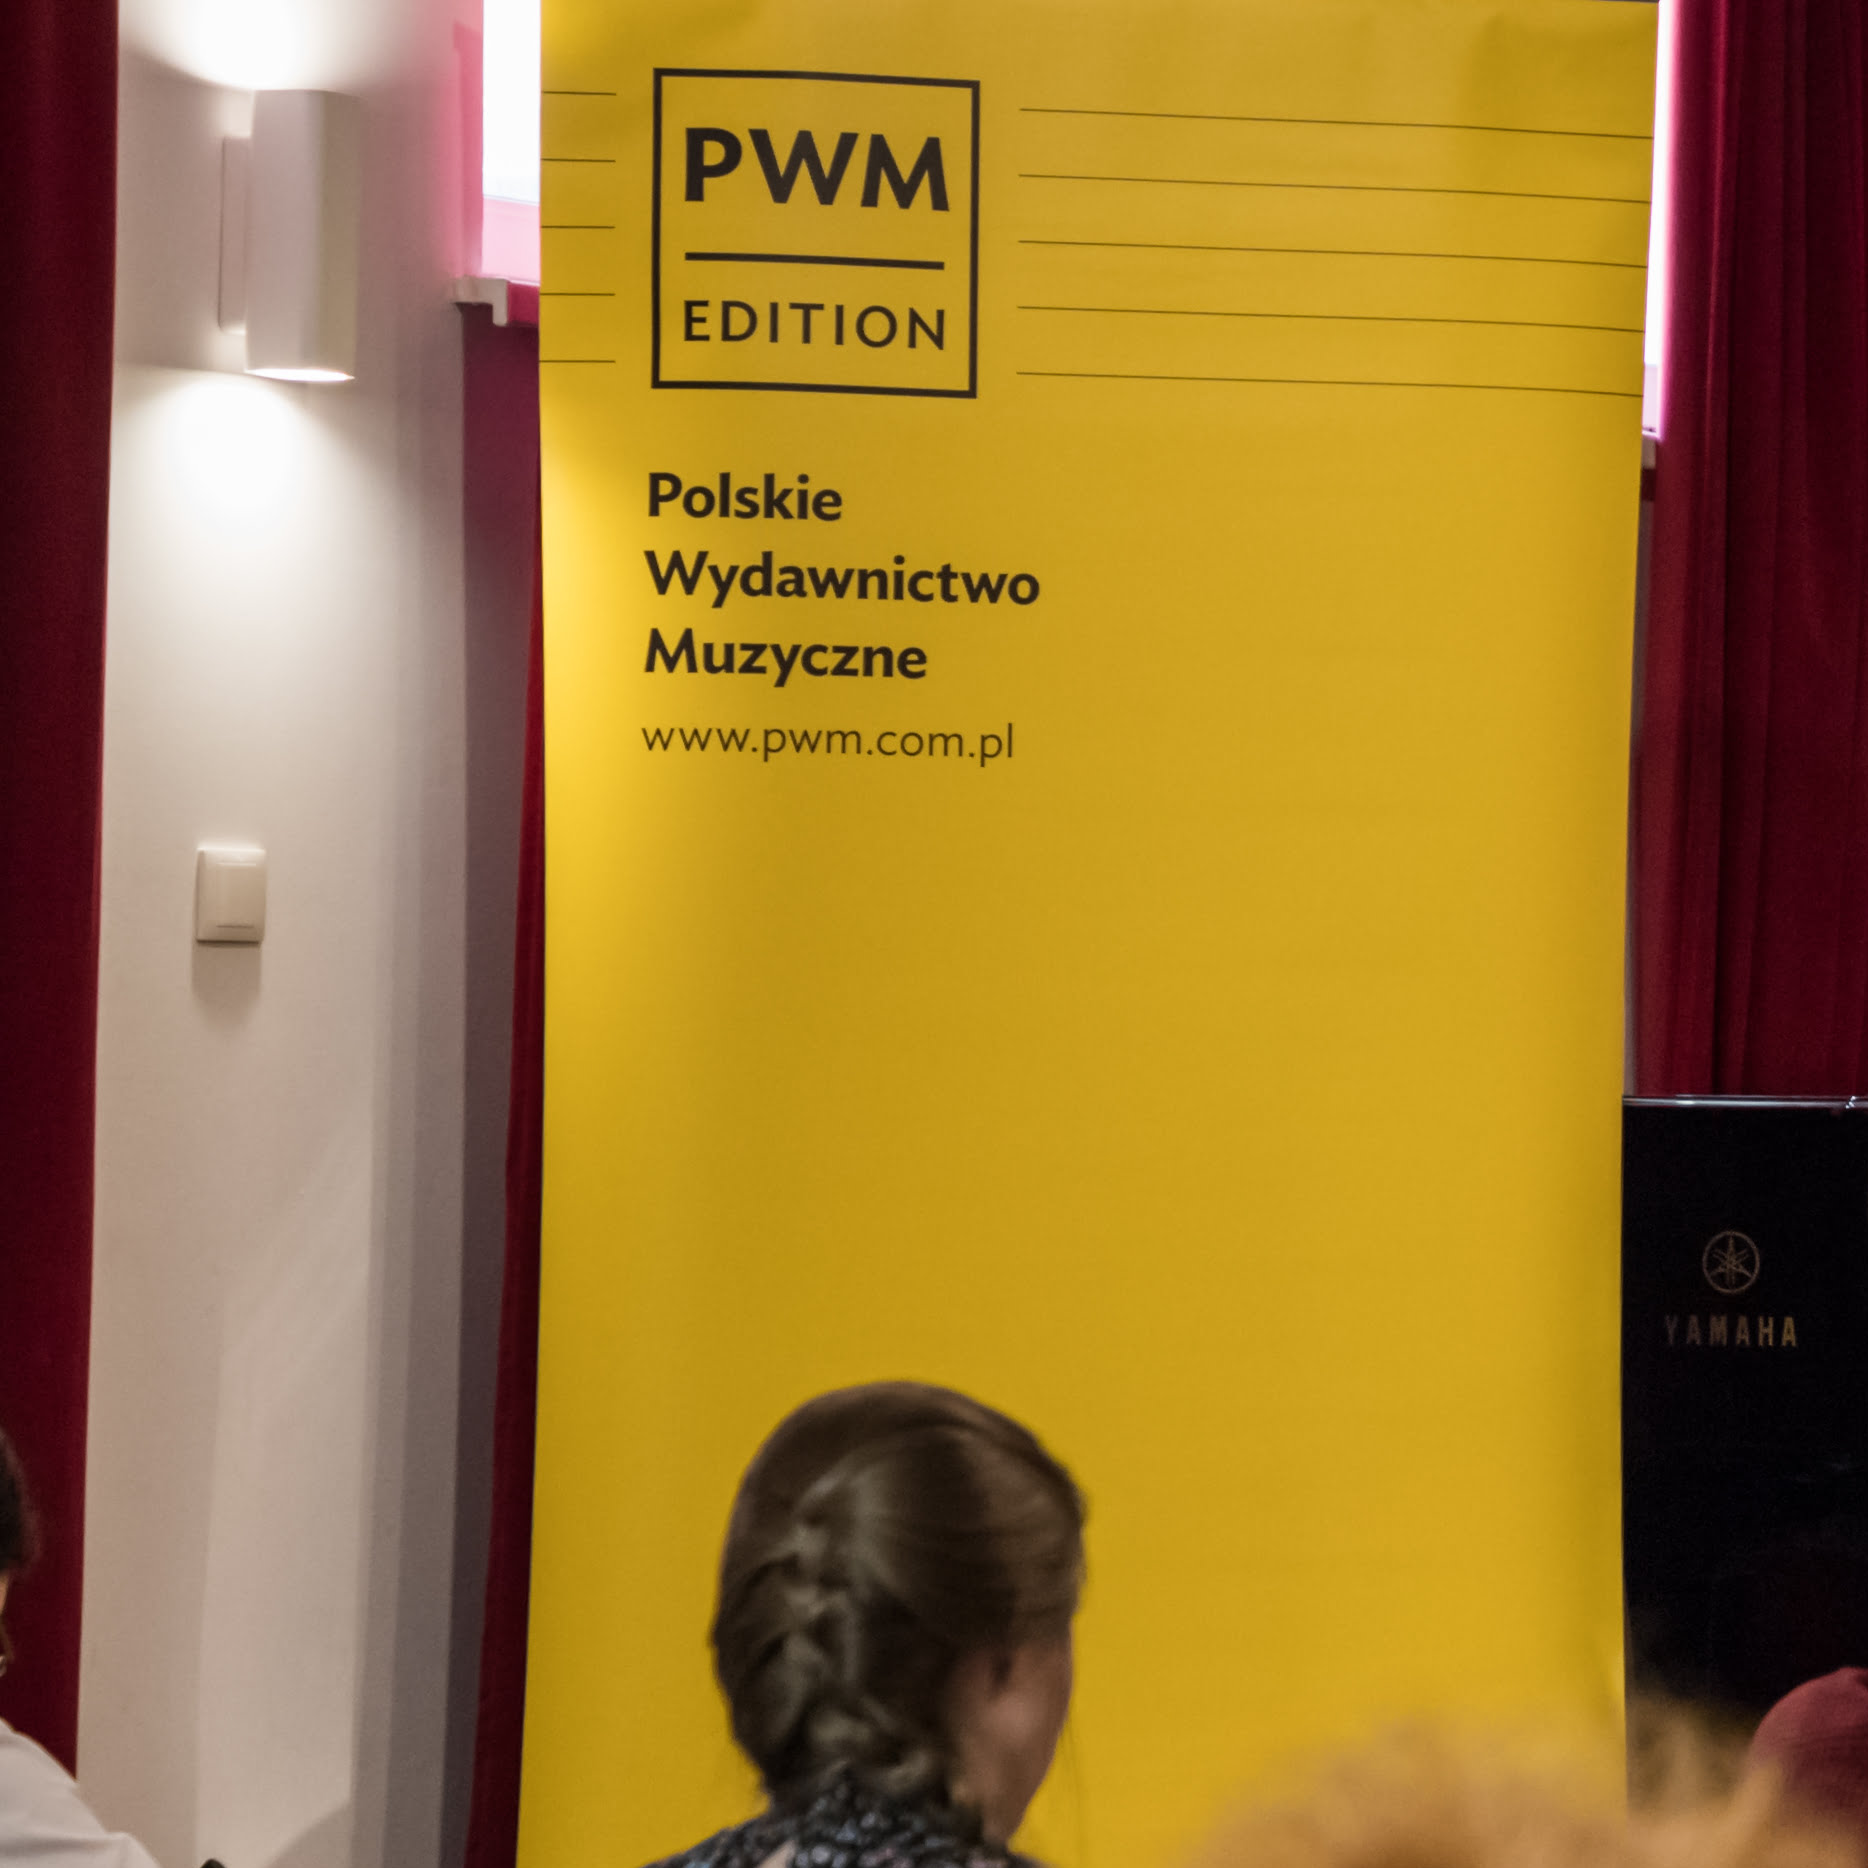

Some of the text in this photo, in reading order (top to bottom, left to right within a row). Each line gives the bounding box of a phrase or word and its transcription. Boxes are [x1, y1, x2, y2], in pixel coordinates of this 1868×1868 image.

[685, 128, 949, 211] PWM
[684, 300, 944, 350] EDITION
[649, 472, 842, 521] Polskie
[645, 550, 1039, 608] Wydawnictwo
[646, 628, 927, 687] Muzyczne
[642, 723, 1012, 767] www.pwm.com.pl
[1664, 1314, 1798, 1348] YAMAHA
